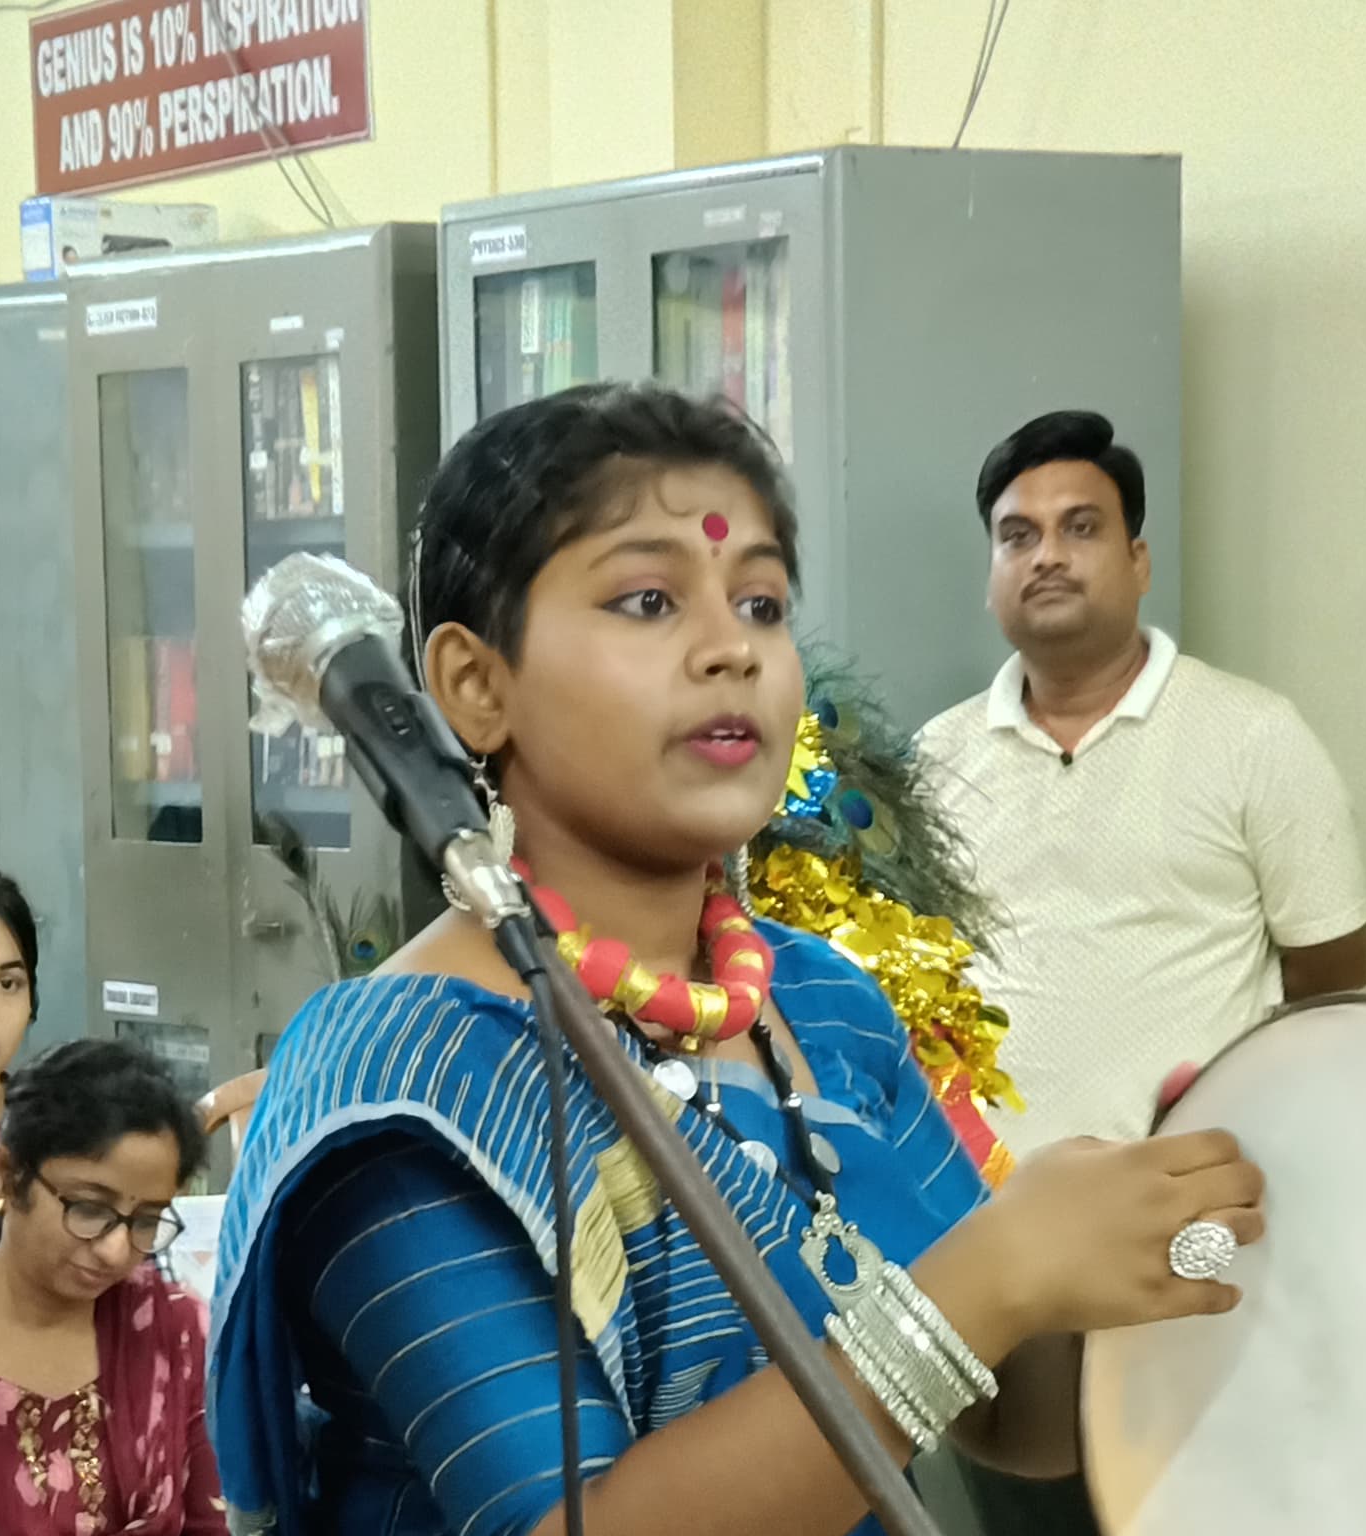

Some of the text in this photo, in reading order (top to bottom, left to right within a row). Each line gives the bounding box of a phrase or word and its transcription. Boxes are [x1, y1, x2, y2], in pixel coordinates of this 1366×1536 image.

[37, 21, 117, 98] GENIUS
[121, 14, 145, 77] IS
[150, 0, 197, 70] 10%
[59, 54, 340, 173] AND 90% PERSPIRATION.
